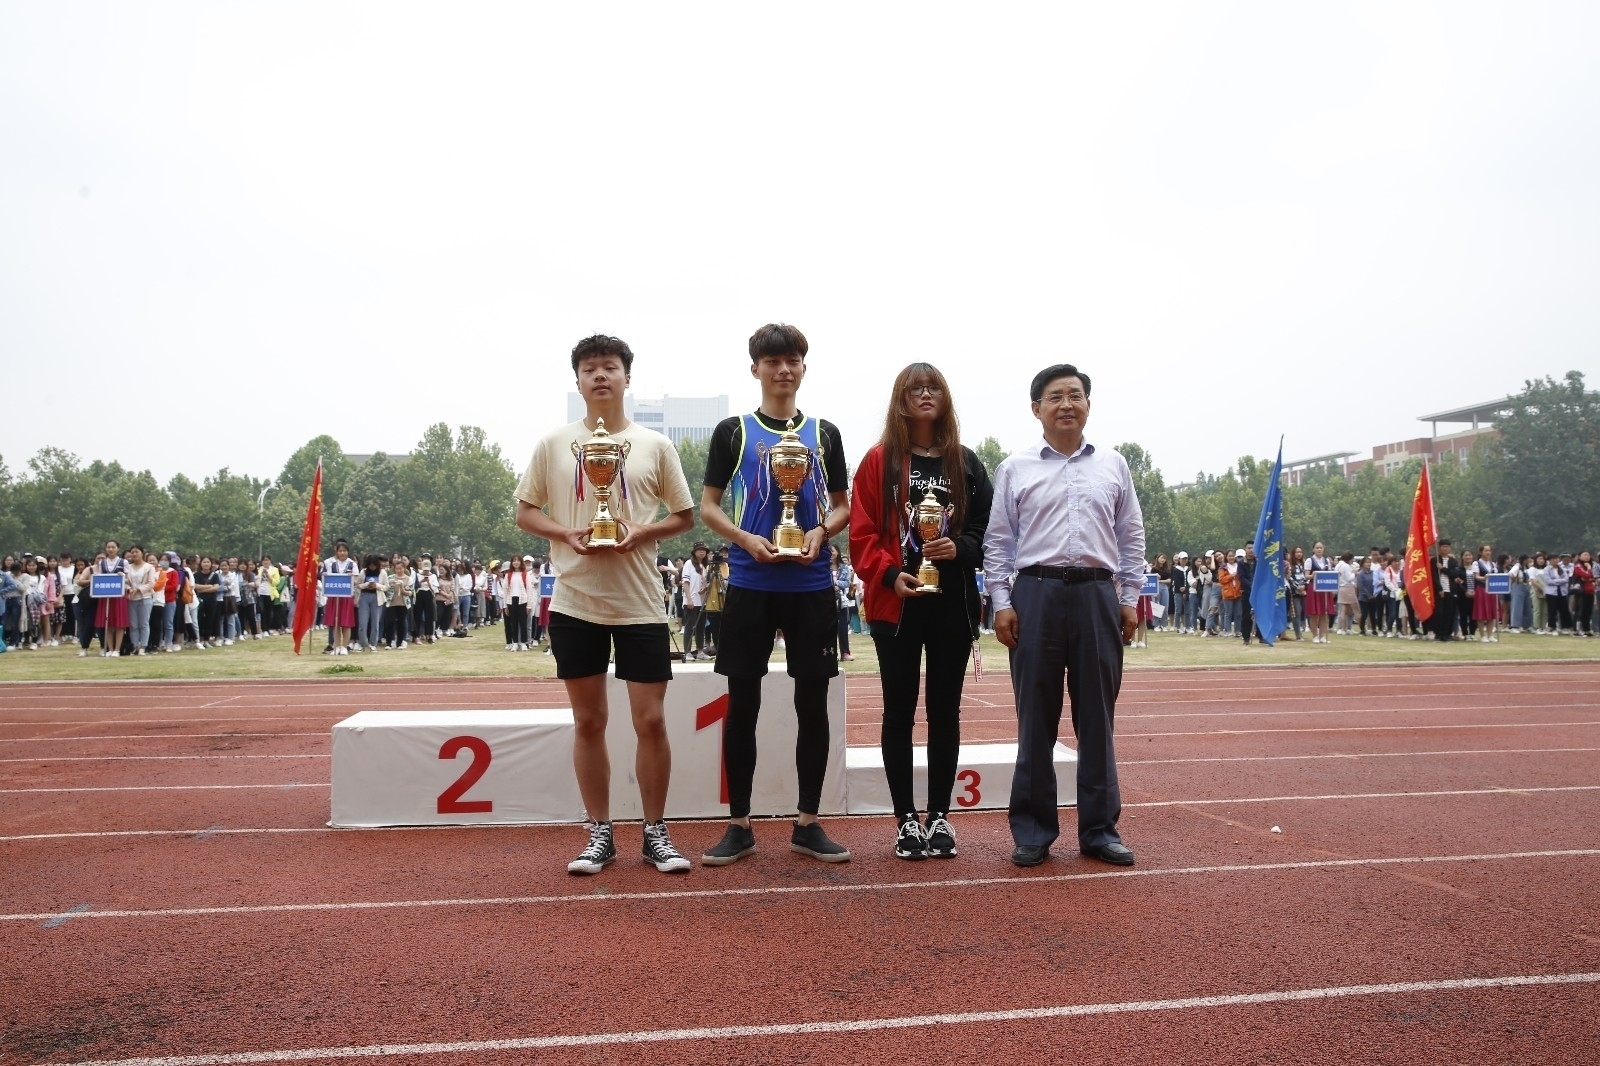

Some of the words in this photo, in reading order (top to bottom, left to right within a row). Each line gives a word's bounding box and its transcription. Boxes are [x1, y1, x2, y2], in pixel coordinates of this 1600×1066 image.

[437, 735, 493, 814] 2
[696, 694, 729, 804] 1
[957, 769, 981, 807] 3
